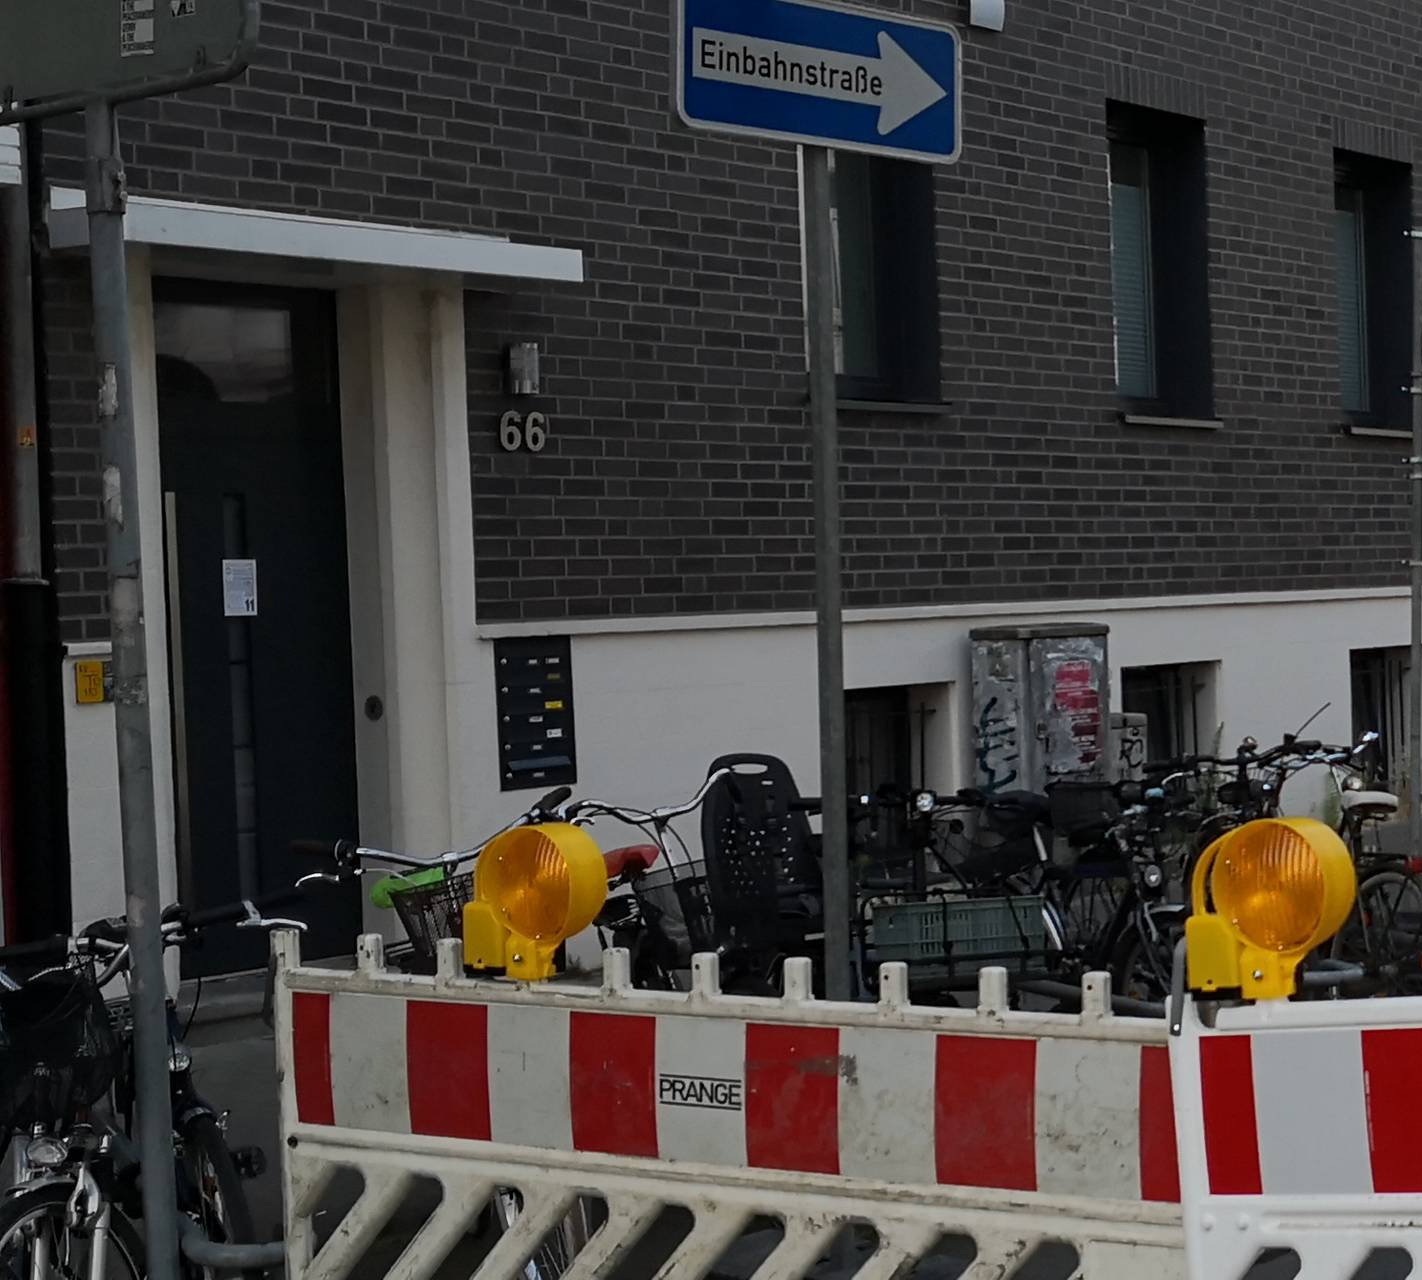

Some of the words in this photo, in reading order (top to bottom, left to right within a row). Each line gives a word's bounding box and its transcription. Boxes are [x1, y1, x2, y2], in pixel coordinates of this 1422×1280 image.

[701, 39, 882, 95] Einbahnstraße
[500, 410, 545, 451] 66
[659, 1078, 742, 1106] PRANGE
